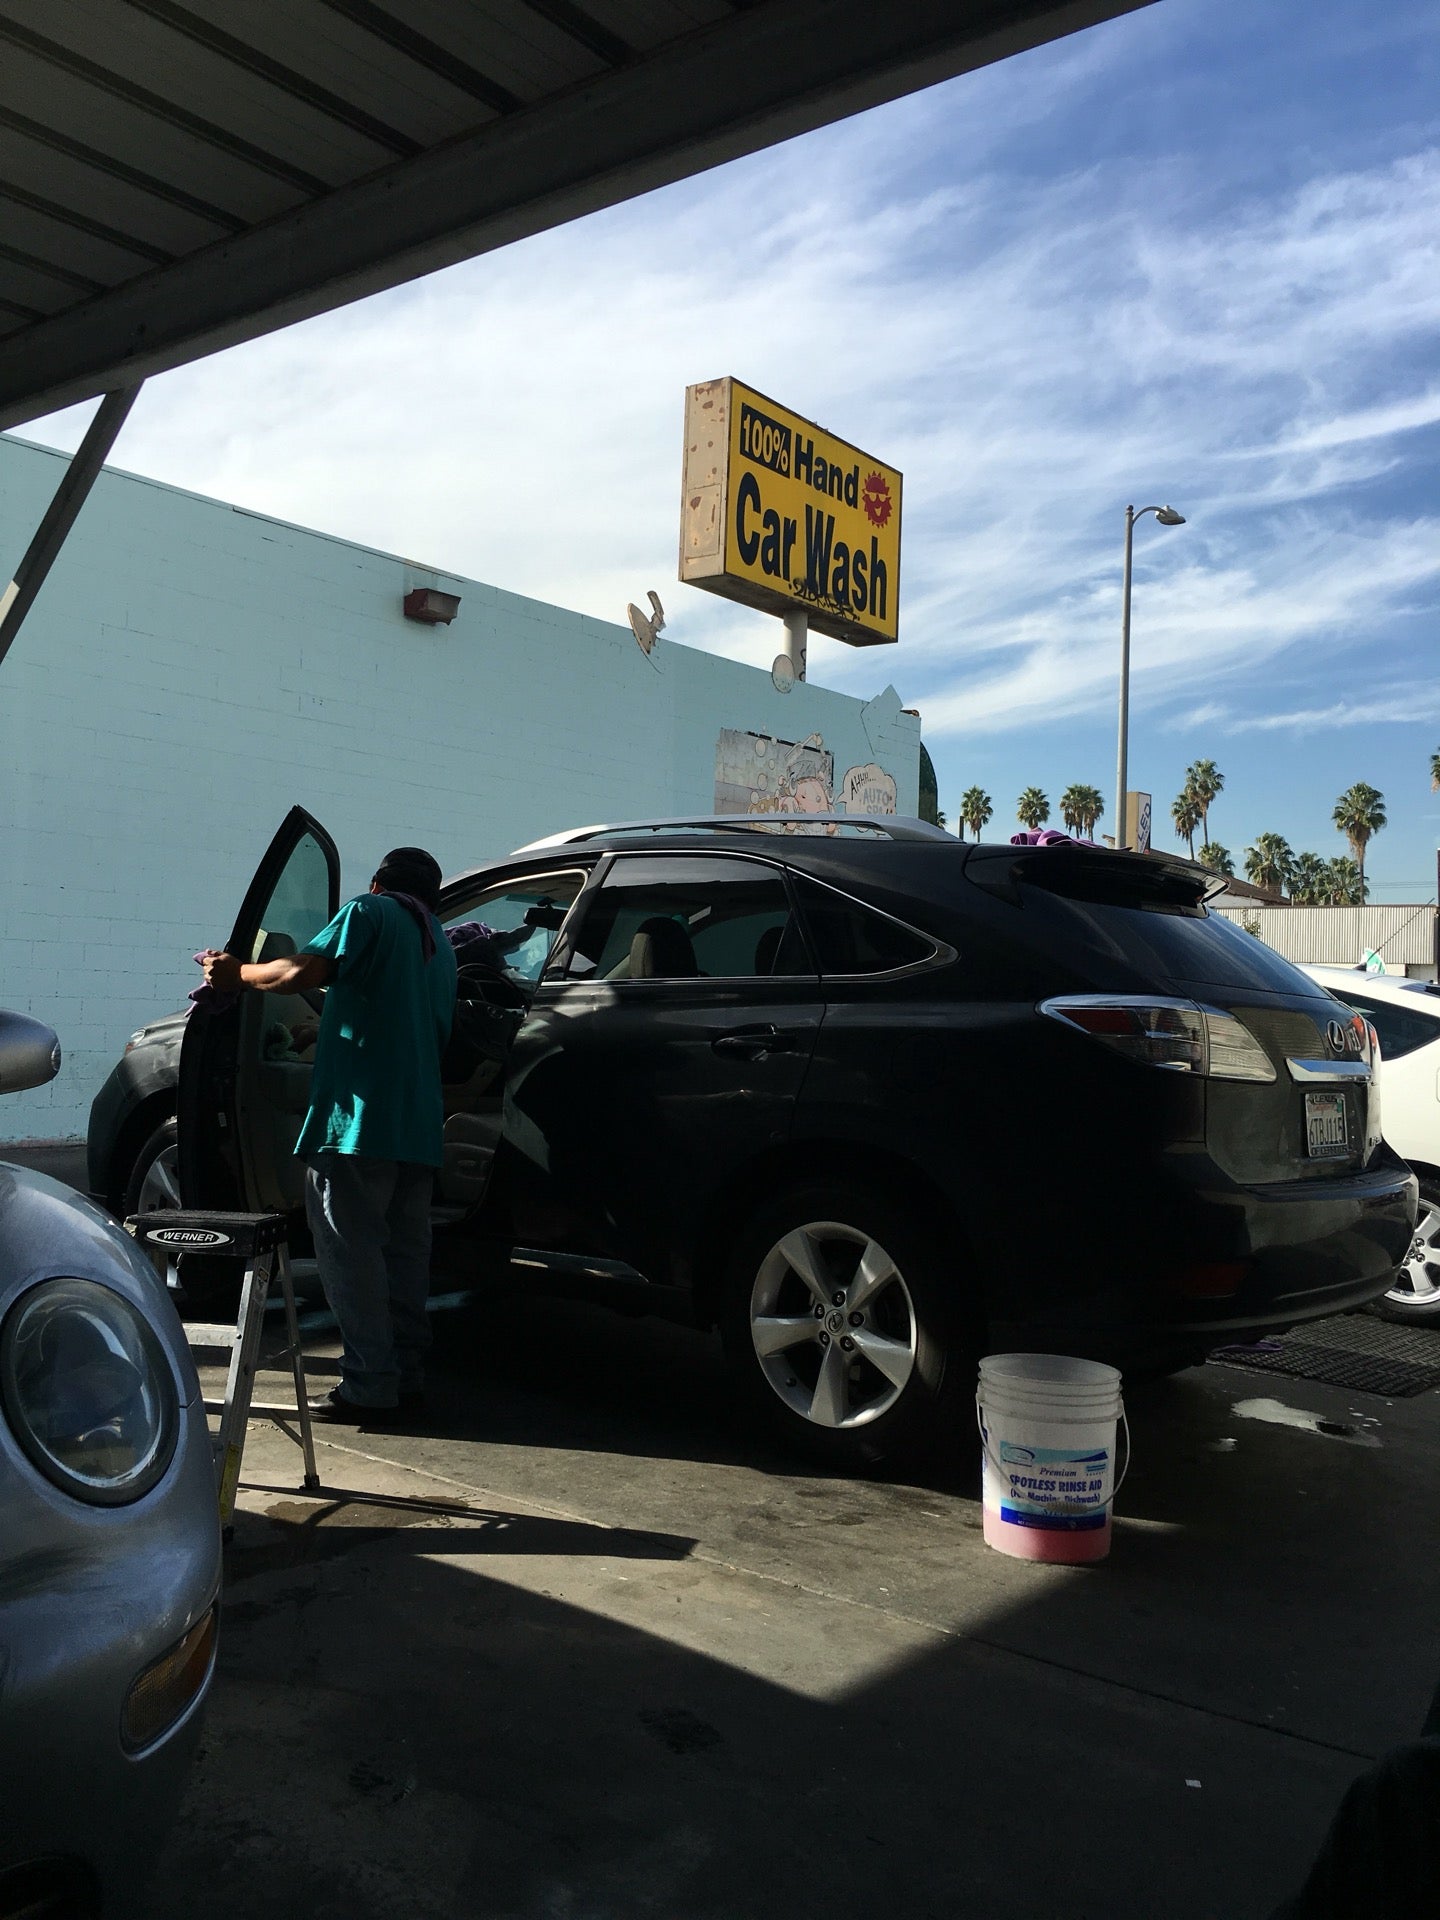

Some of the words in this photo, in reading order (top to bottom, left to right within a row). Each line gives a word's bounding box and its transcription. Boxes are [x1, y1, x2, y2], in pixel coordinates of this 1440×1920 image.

[743, 413, 788, 473] 100%
[794, 432, 859, 510] Hand
[736, 471, 797, 583] Car
[804, 503, 887, 621] Wash
[863, 788, 889, 806] AUTO
[1138, 803, 1150, 841] LED
[164, 1231, 214, 1242] WERNER
[1039, 1467, 1077, 1477] Premium
[1009, 1474, 1056, 1491] SPOTLESS
[1058, 1480, 1087, 1492] RINSE
[1089, 1479, 1103, 1491] AID
